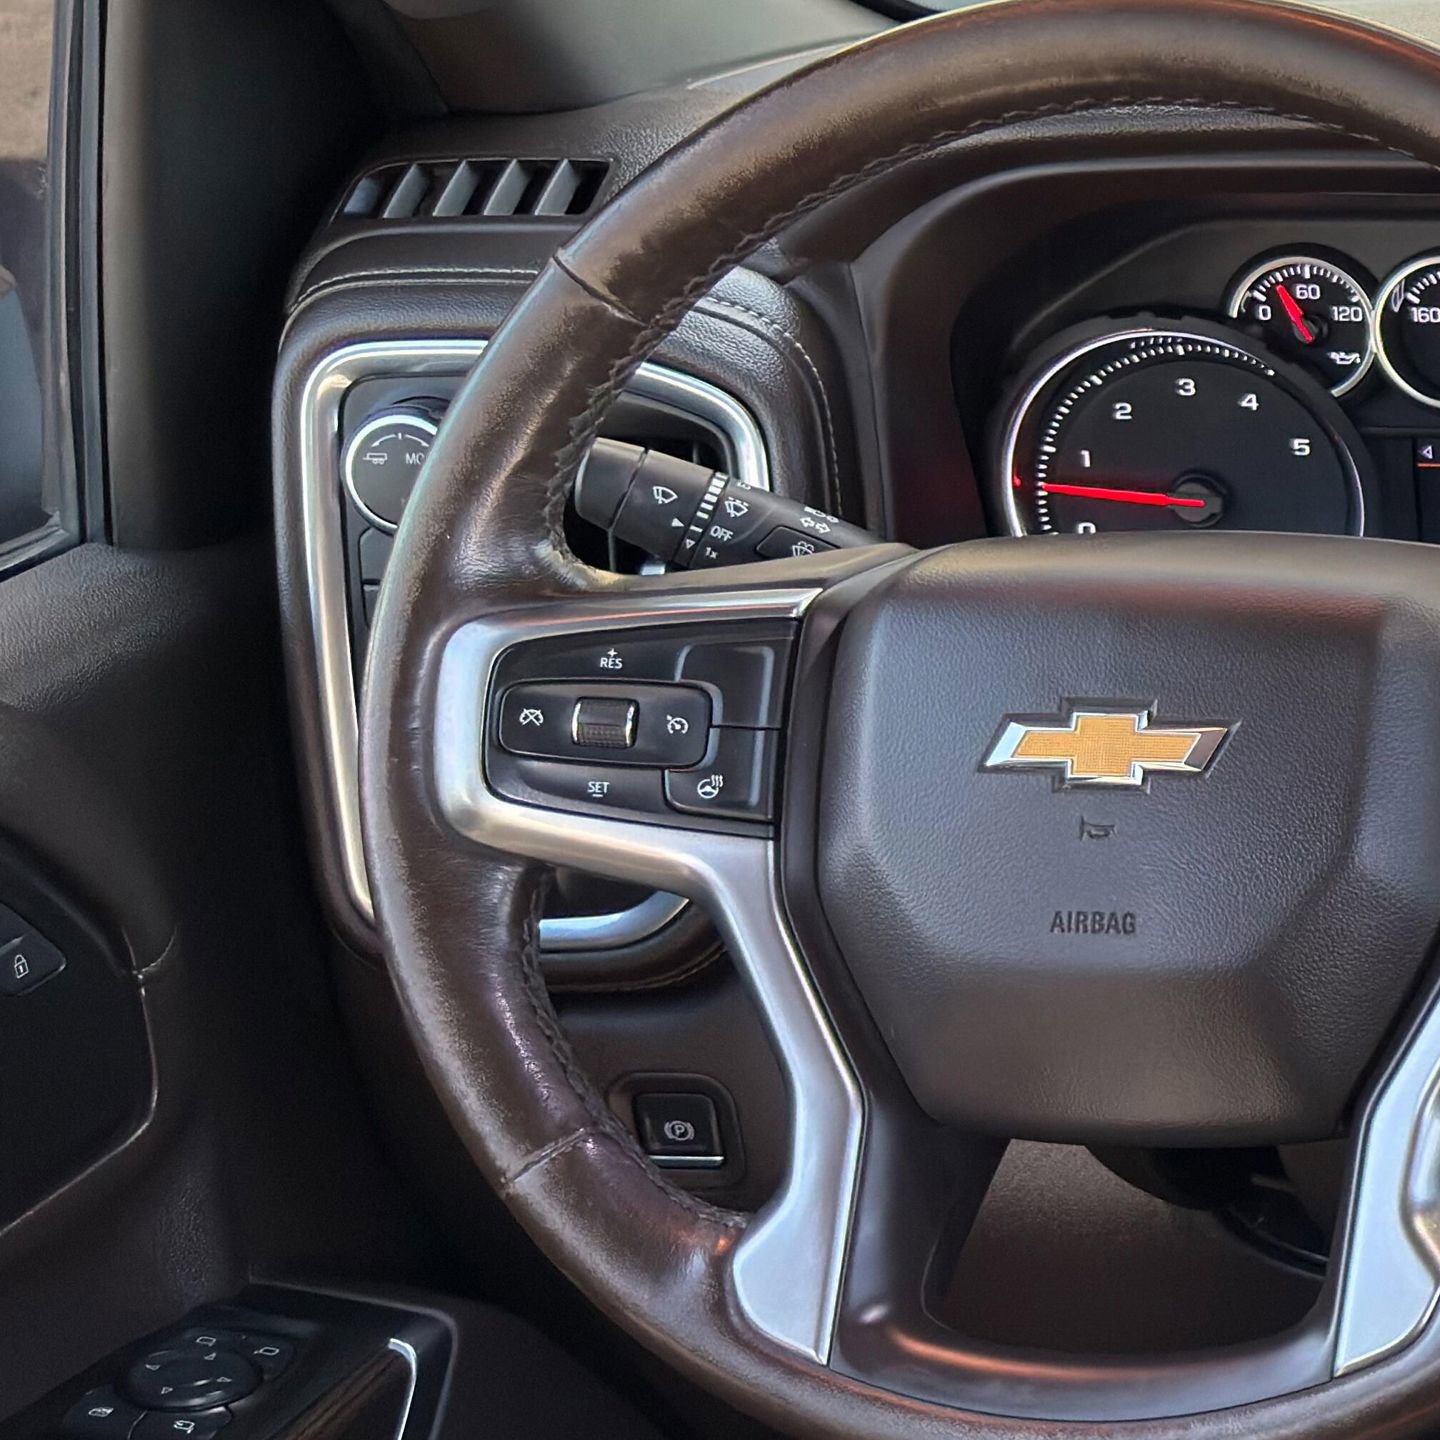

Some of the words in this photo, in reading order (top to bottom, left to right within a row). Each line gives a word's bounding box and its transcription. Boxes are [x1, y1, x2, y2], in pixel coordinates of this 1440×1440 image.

[1296, 283, 1320, 300] 60
[1258, 305, 1272, 322] 0
[1331, 305, 1364, 323] 120
[1175, 378, 1197, 397] 3
[1112, 402, 1133, 420] 2
[1237, 393, 1260, 411] 4
[1289, 438, 1311, 457] 5
[1080, 449, 1091, 468] 1
[709, 525, 735, 543] OFF
[600, 656, 624, 670] RES
[587, 780, 611, 794] SET
[1050, 910, 1138, 935] AIRBAG
